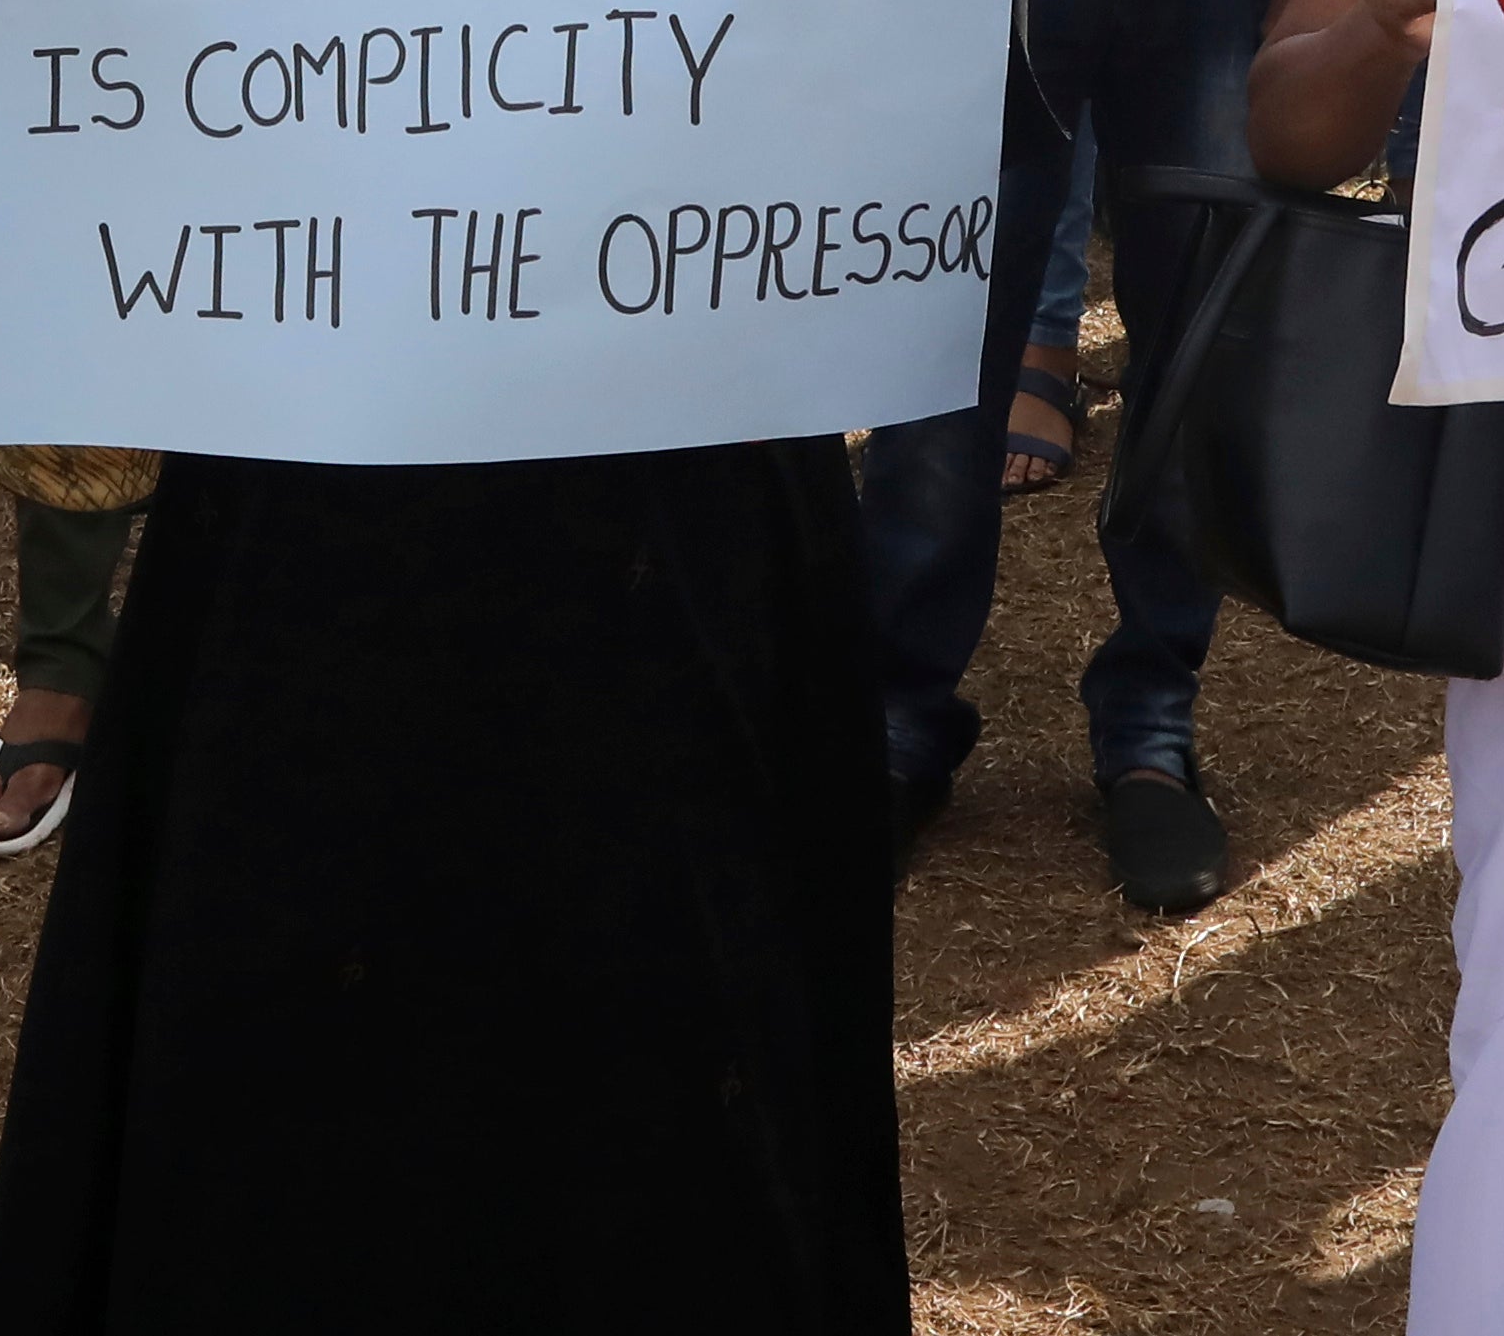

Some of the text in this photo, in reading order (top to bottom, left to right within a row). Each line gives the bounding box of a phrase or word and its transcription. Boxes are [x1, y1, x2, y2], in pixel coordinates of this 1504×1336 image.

[27, 45, 145, 136] IS
[100, 193, 995, 329] WITH THE OPPRESSOR
